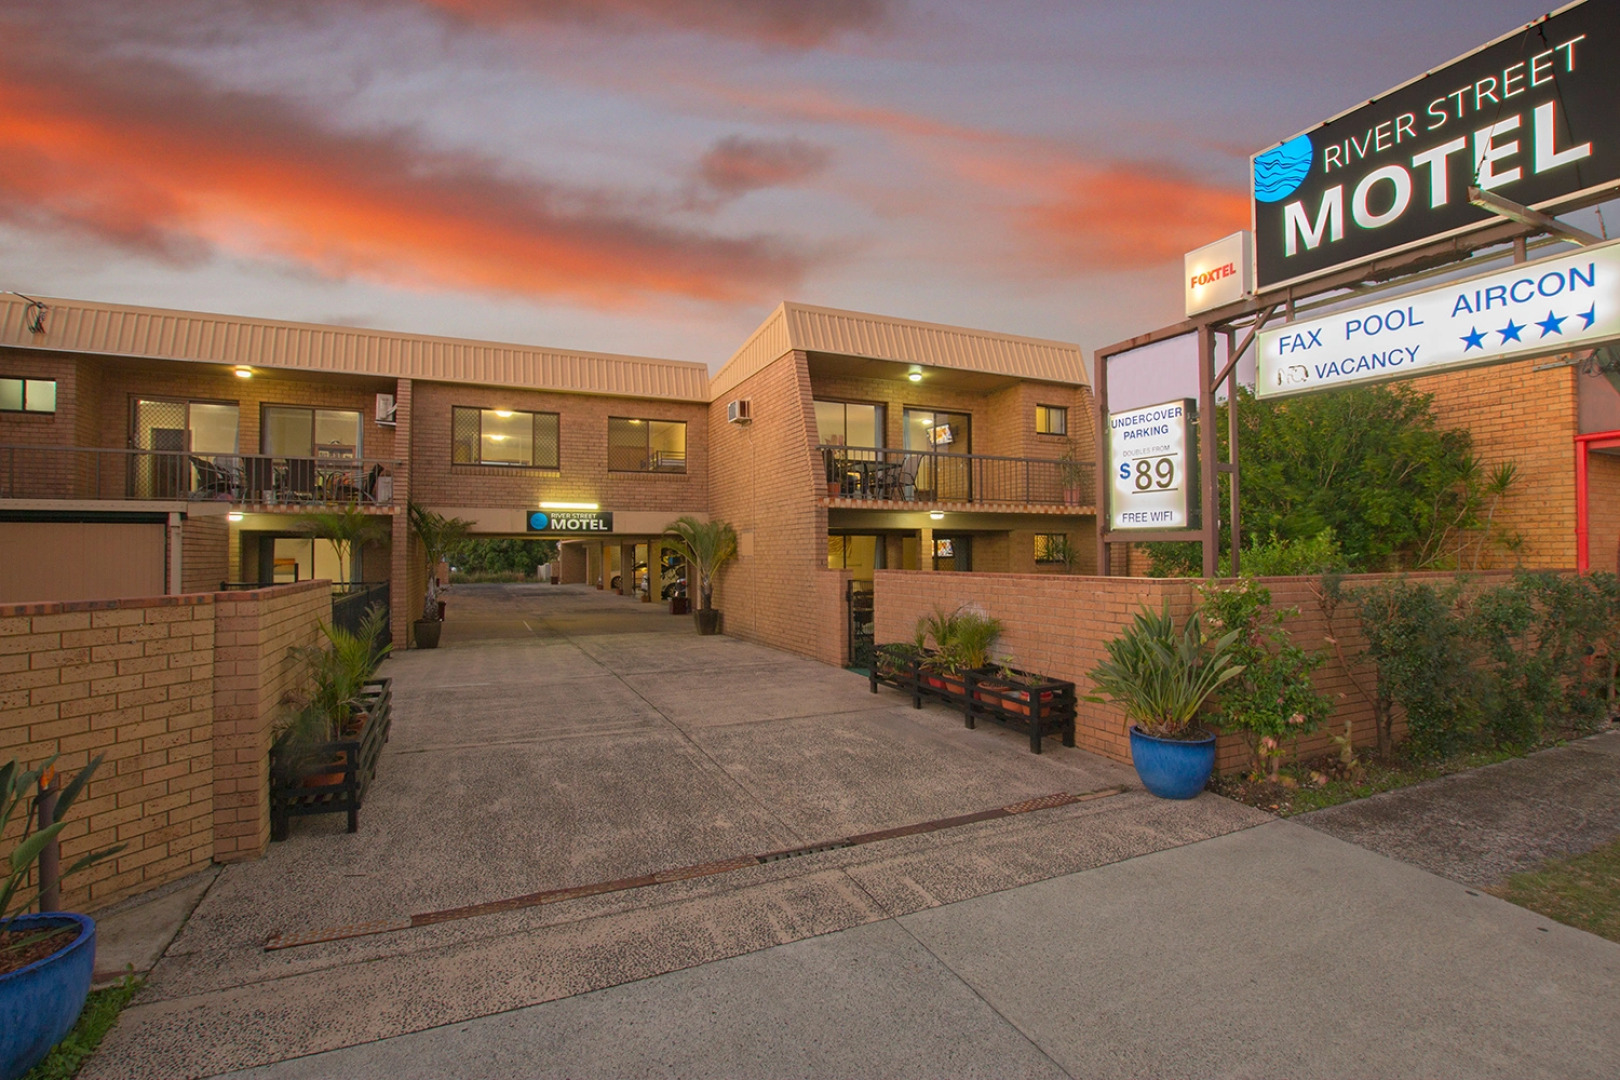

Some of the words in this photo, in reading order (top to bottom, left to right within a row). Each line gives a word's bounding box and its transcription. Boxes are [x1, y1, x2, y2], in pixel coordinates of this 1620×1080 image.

[1324, 112, 1417, 173] RIVER
[1427, 34, 1586, 131] STREET
[1283, 100, 1592, 258] MOTEL
[1190, 262, 1236, 289] FOXTEL
[1279, 328, 1323, 355] FAX
[1346, 306, 1424, 340] POOL
[1451, 262, 1596, 318] AIRCON
[1314, 345, 1420, 379] VACANCY
[1110, 406, 1183, 429] UNDERCOVER
[1123, 424, 1169, 441] PARKING
[1122, 447, 1150, 458] DOUBLES
[1151, 444, 1171, 452] FROM
[551, 518, 608, 530] MOTEL
[1122, 512, 1148, 523] FREE
[1150, 510, 1173, 522] WIFI
